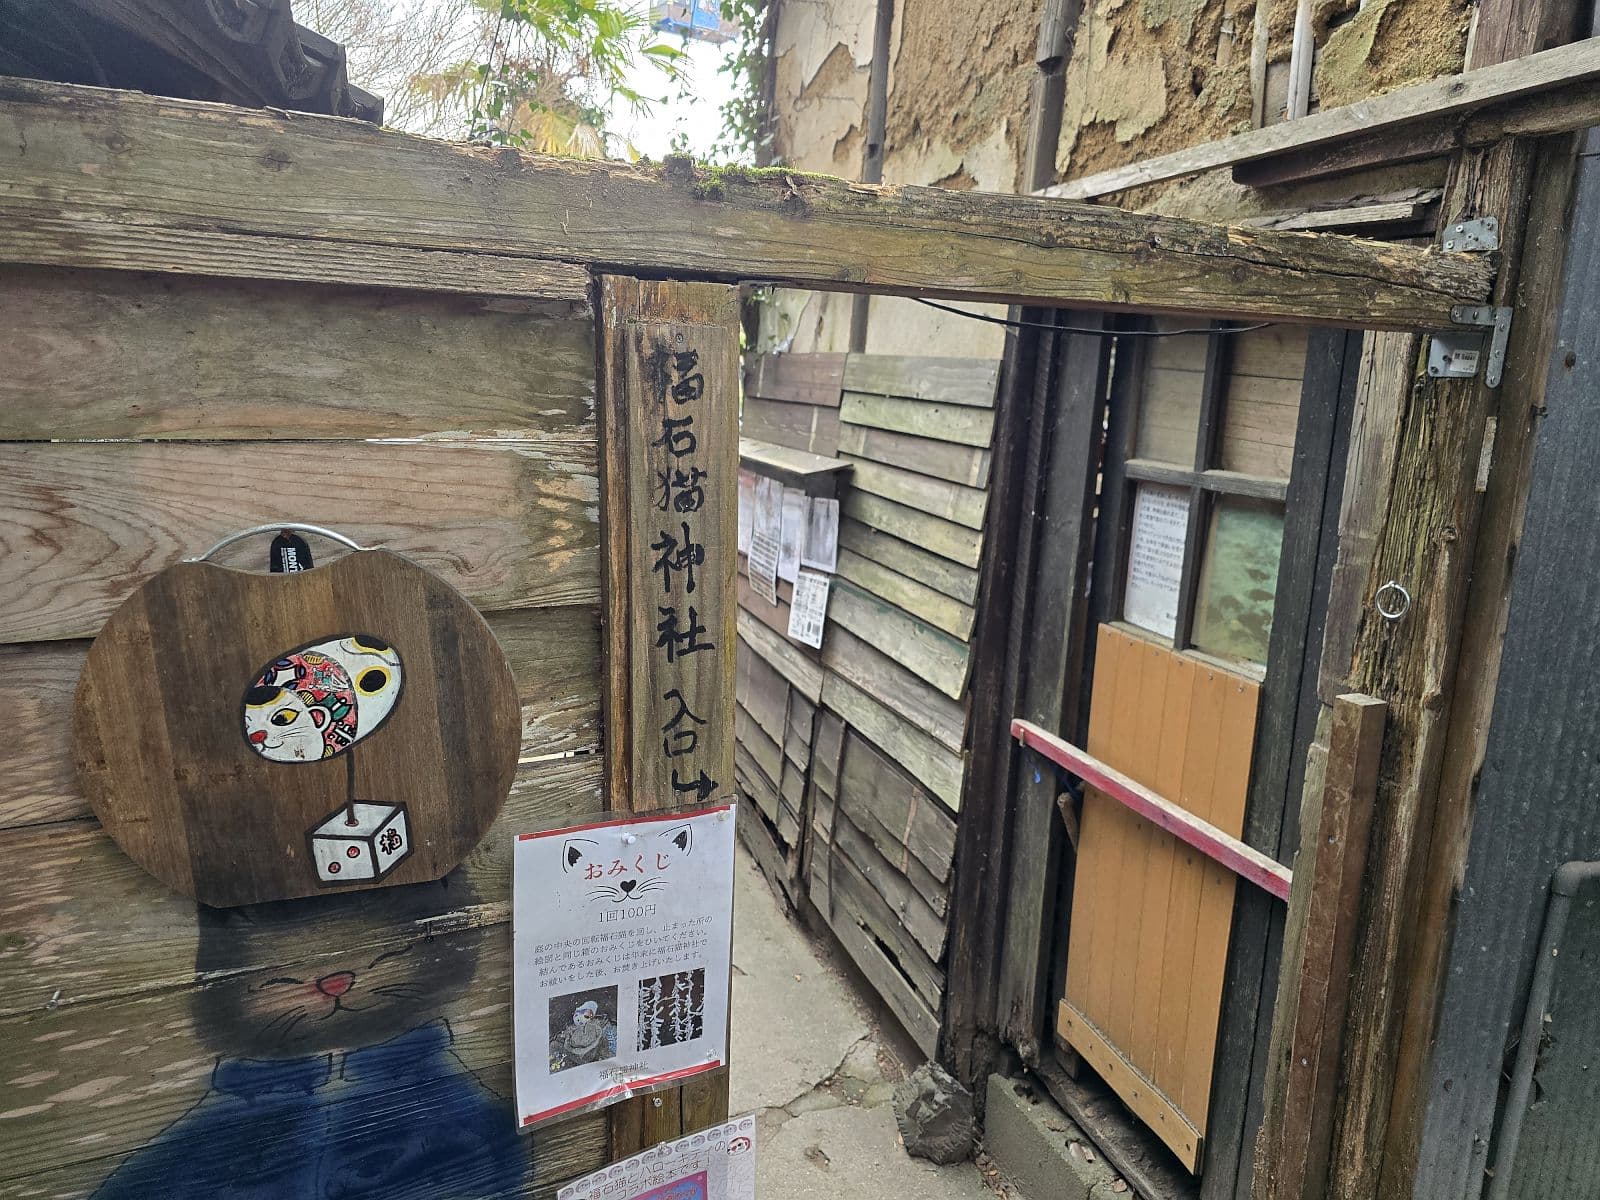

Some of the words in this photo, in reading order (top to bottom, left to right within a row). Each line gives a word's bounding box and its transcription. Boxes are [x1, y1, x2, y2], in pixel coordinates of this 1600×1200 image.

[651, 349, 715, 663] 福石猫神社
[661, 688, 707, 757] 入口
[380, 828, 402, 855] 福
[584, 853, 672, 880] おみくじ
[599, 904, 656, 922] 1回100円
